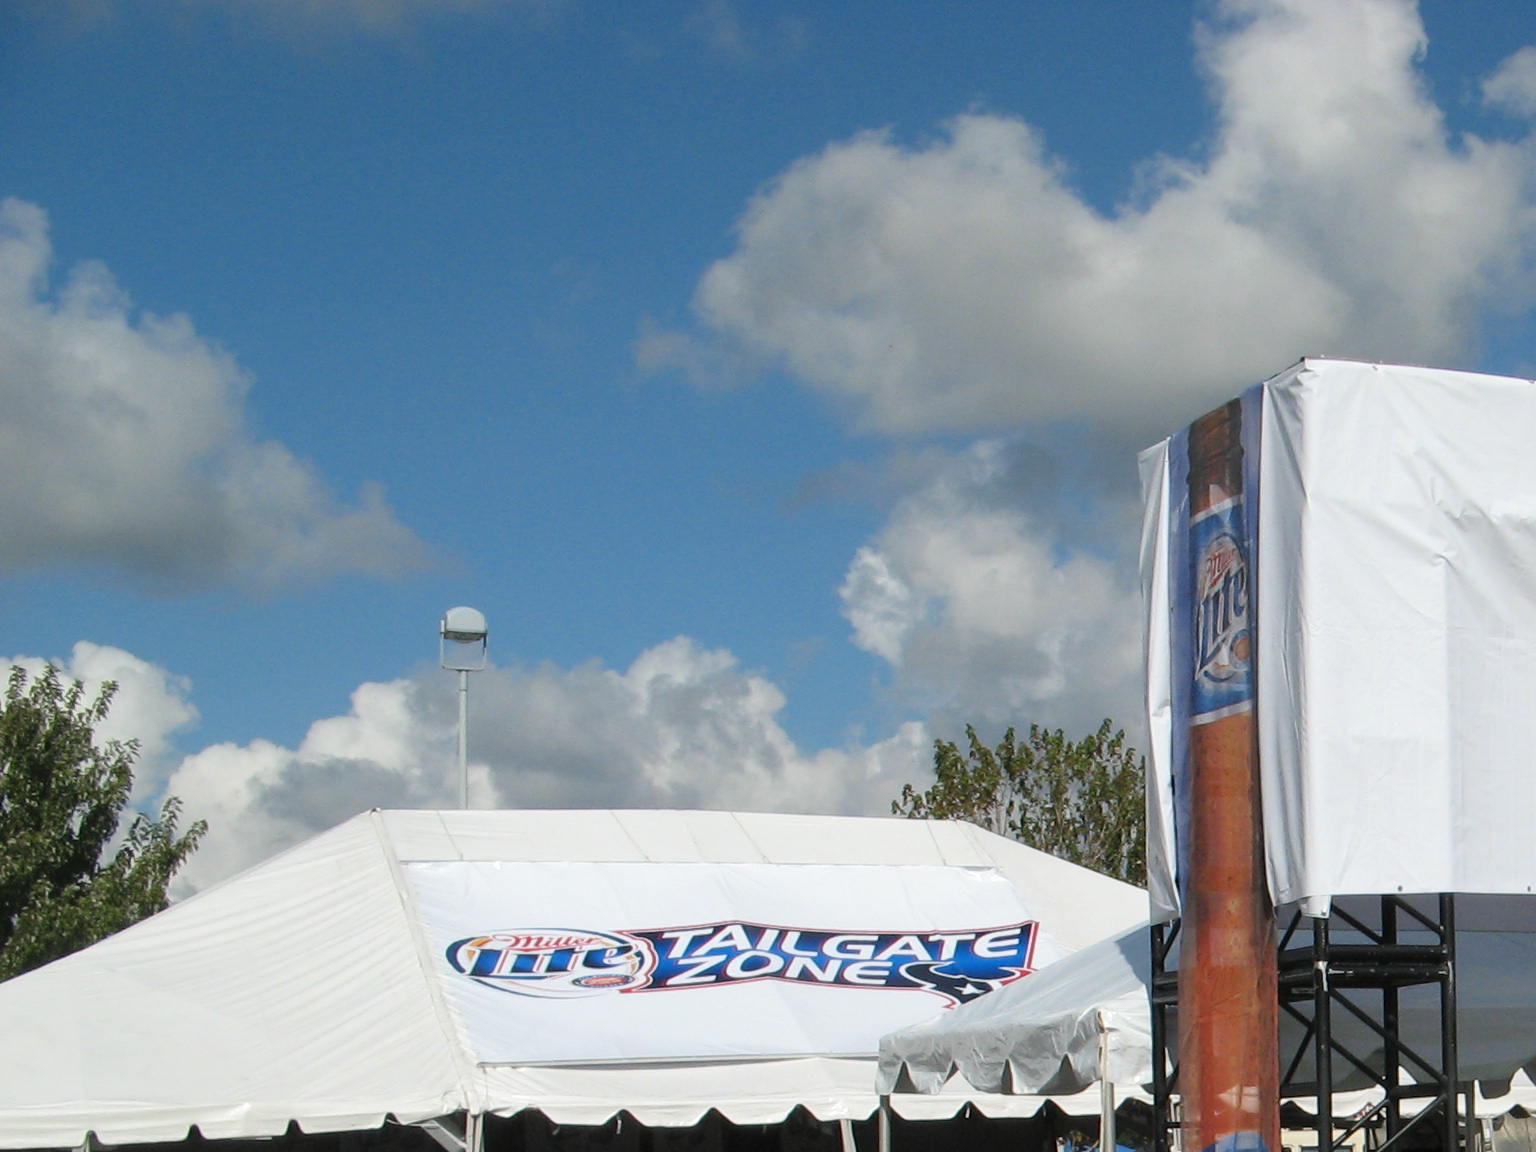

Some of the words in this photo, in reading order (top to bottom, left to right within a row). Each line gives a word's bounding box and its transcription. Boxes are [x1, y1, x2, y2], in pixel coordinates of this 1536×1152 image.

[492, 934, 600, 949] Miller
[663, 924, 1023, 961] TAILGATE
[469, 945, 633, 980] Lite
[666, 951, 890, 987] ZONE
